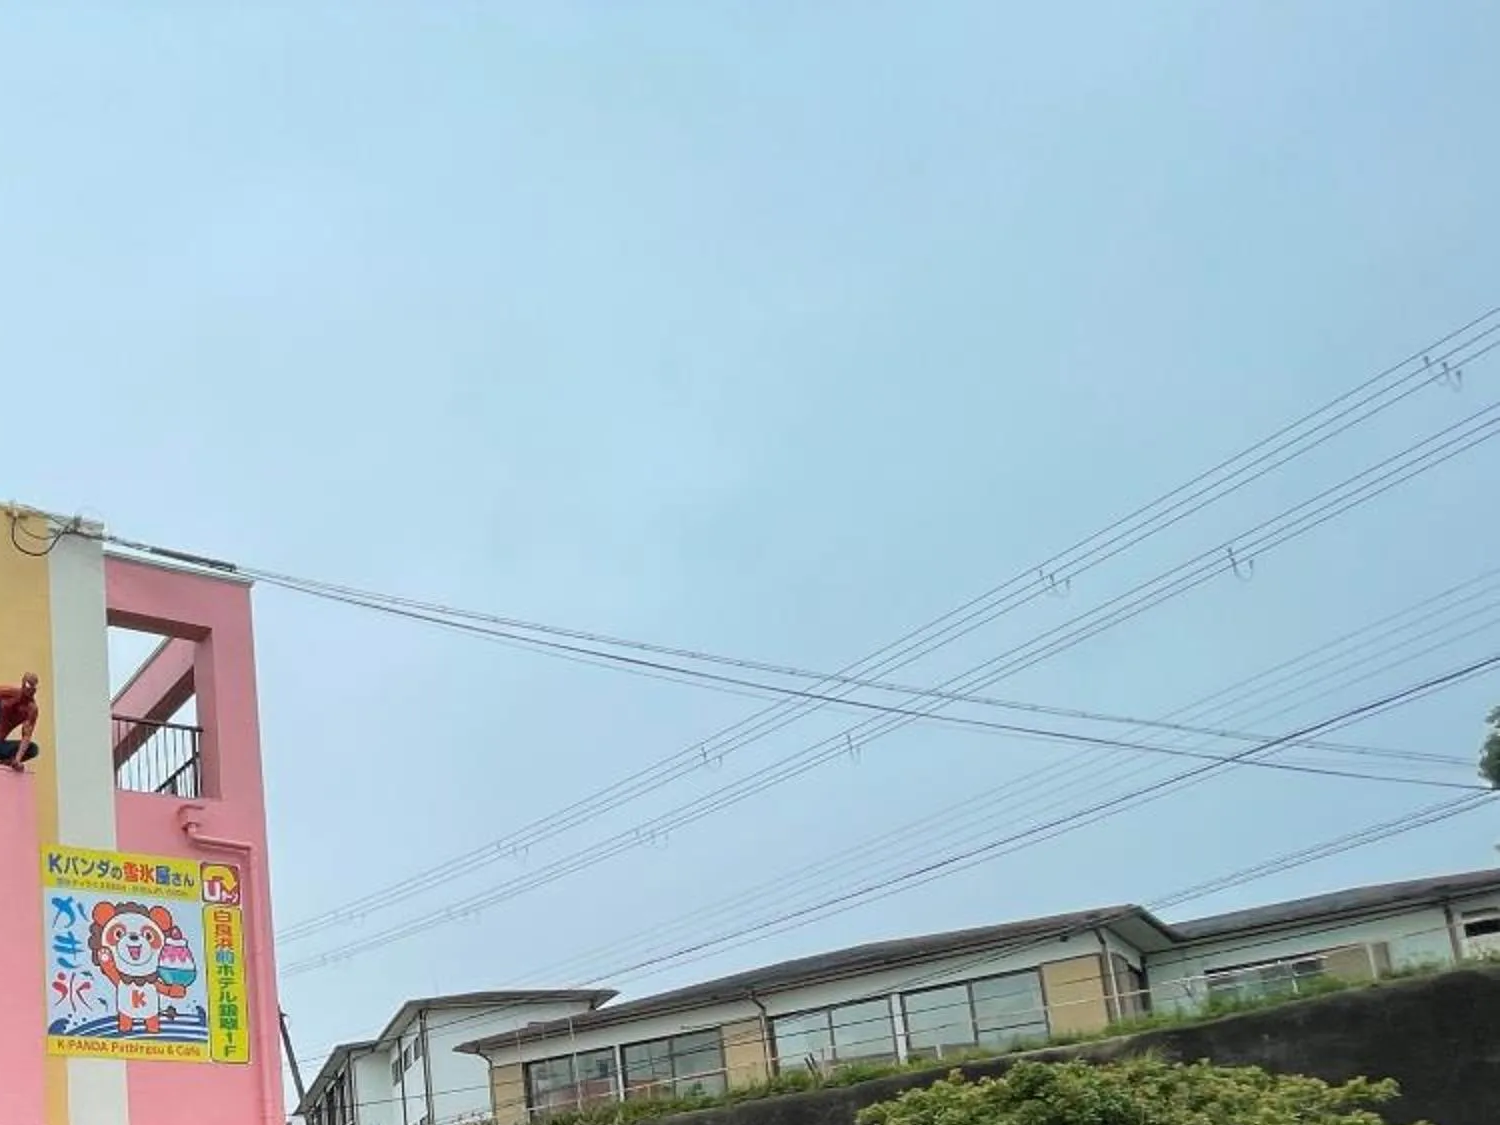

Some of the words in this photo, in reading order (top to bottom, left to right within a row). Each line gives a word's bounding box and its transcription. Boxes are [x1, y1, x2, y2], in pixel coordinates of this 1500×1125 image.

[51, 896, 92, 1013] かき氷
[132, 990, 146, 1008] K
